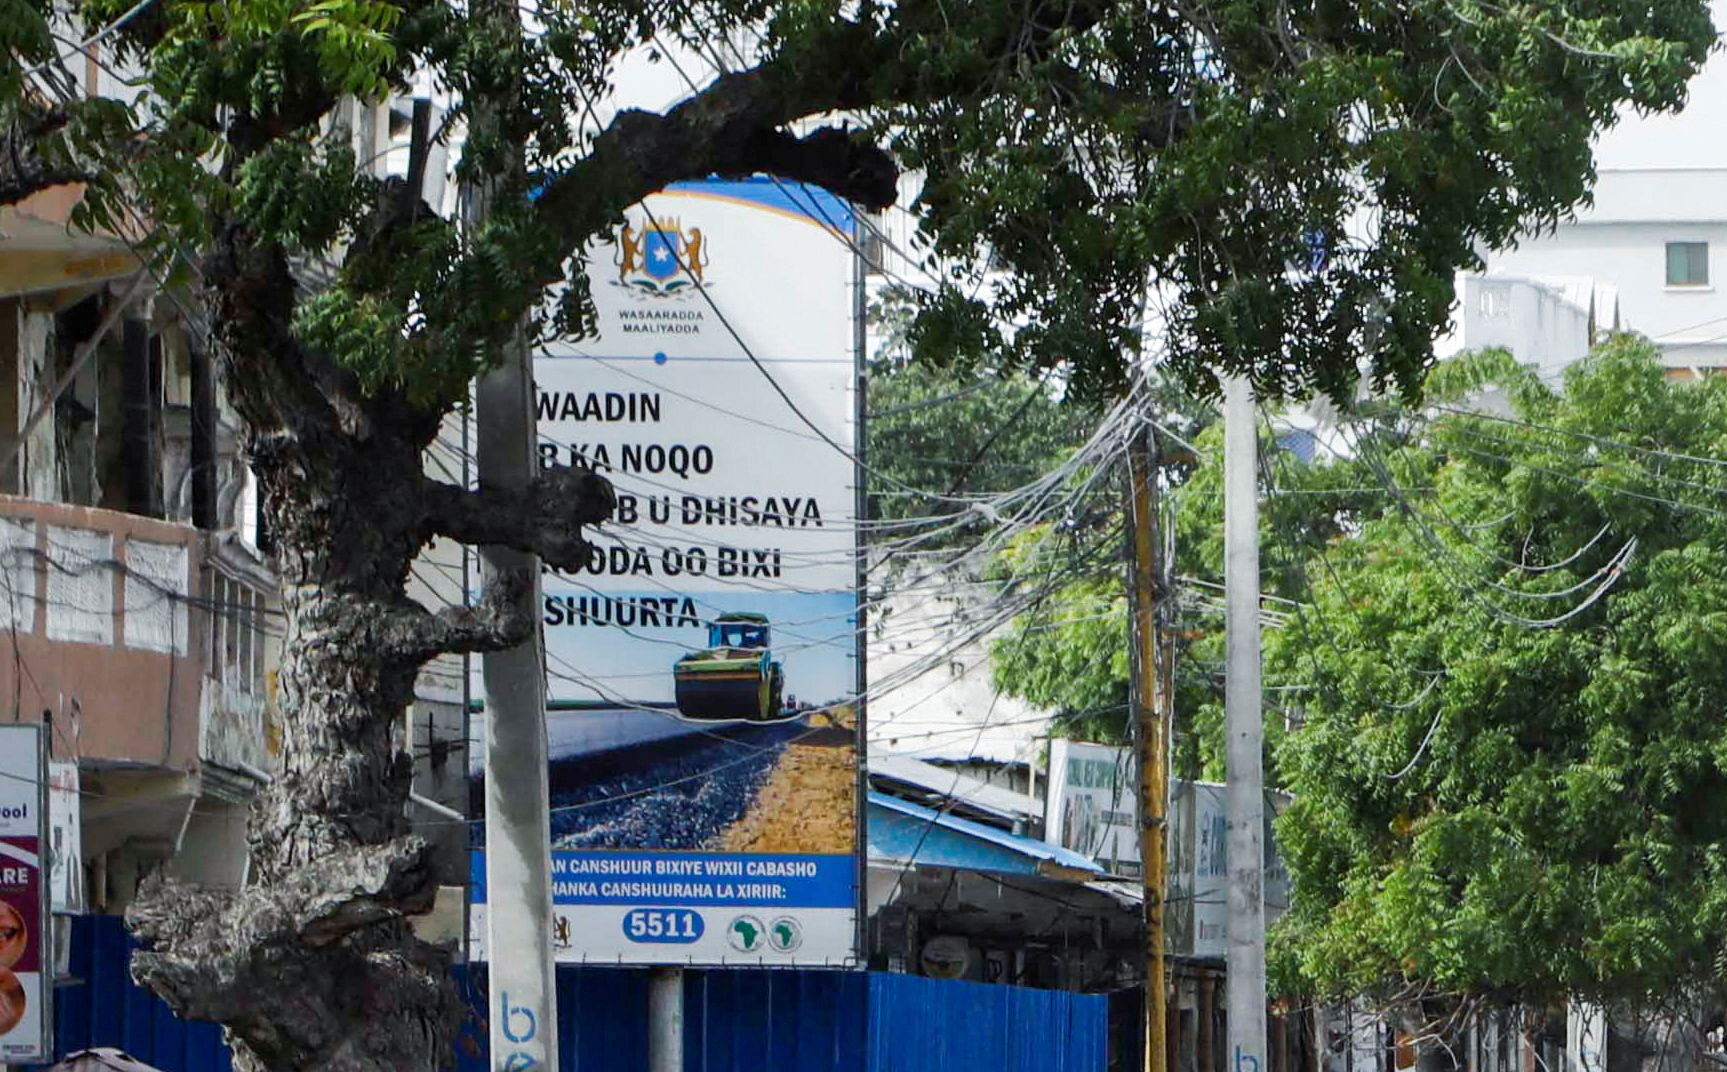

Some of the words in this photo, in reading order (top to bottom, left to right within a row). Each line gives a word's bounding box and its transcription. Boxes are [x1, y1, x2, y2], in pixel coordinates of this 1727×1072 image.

[618, 309, 704, 321] WASAARADDA
[622, 323, 700, 334] MAALIYADDA
[621, 444, 715, 480] NOQO
[650, 496, 671, 525] U
[681, 496, 824, 527] DHISAYA
[717, 548, 781, 578] BIXI
[544, 596, 701, 628] SHUURTA
[0, 867, 28, 884] RE
[570, 860, 652, 876] CANSHUUR
[656, 861, 703, 876] BIXIYE
[705, 862, 742, 876] WIXII
[746, 862, 817, 878] CABASHO
[601, 883, 713, 898] CANSHUURAHA
[716, 884, 733, 899] LA
[736, 883, 787, 900] XIRIIR:
[630, 912, 697, 938] 5511
